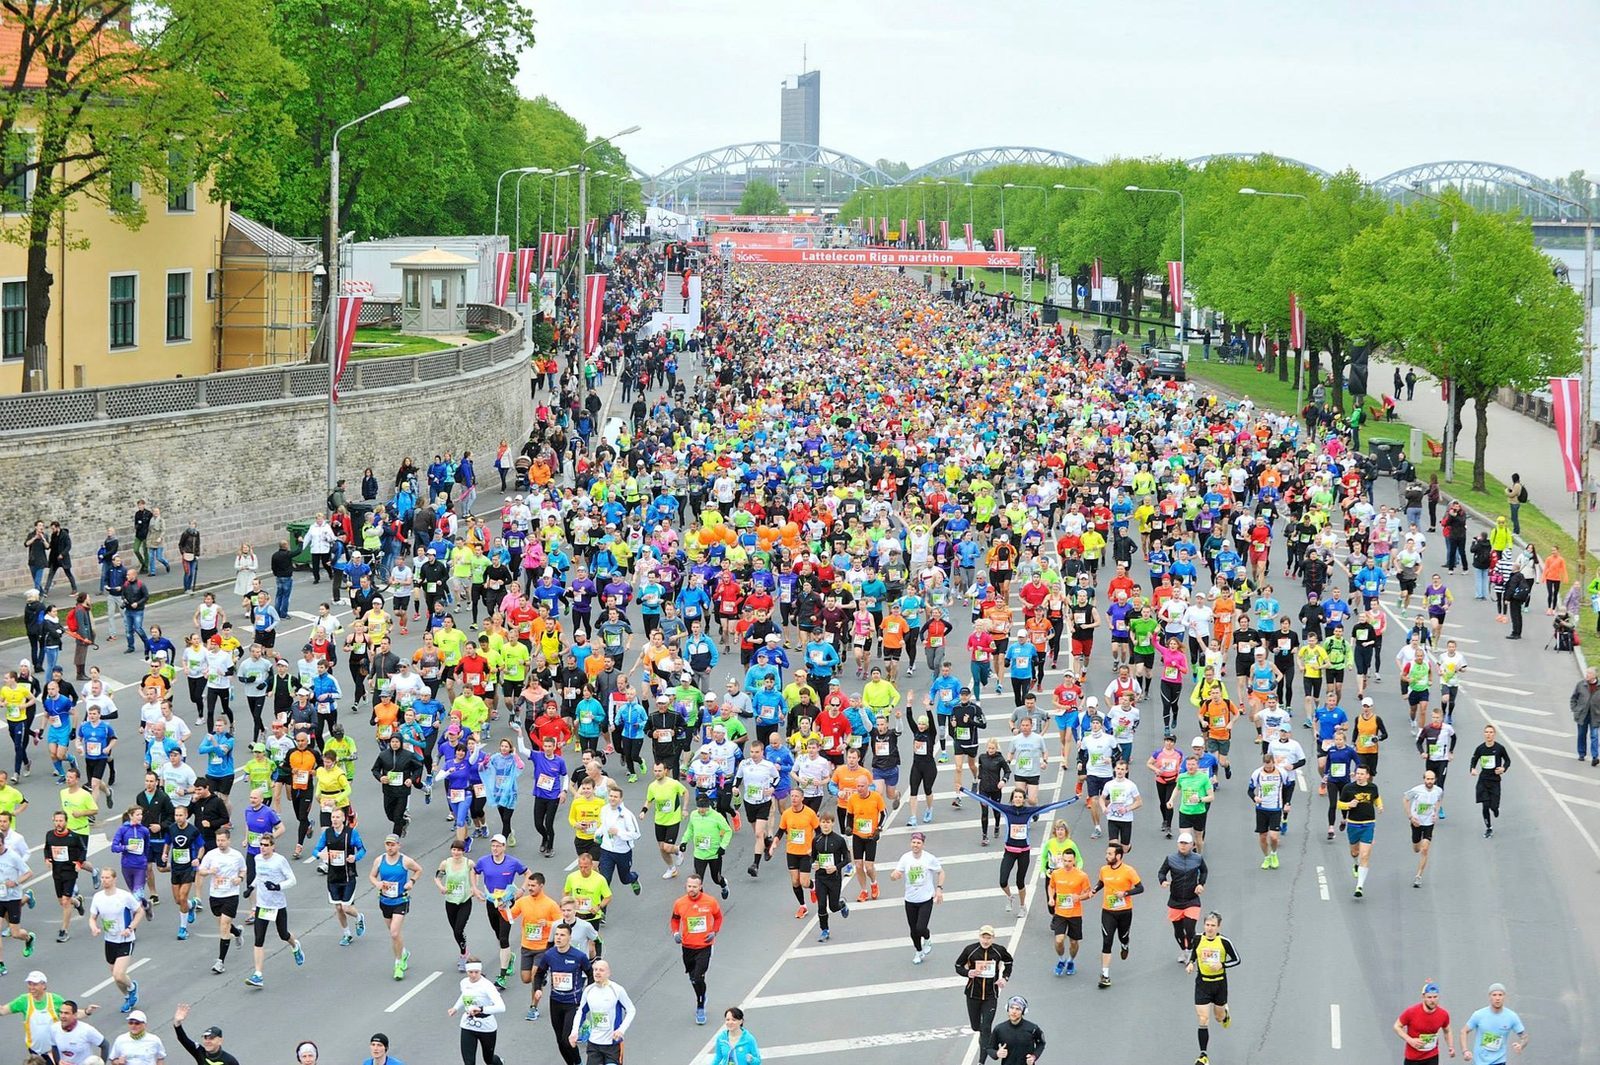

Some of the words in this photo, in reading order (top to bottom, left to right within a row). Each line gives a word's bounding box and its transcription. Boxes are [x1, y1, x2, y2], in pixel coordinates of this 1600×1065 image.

[802, 252, 866, 261] Lattelecom
[869, 252, 895, 263] Riga
[898, 252, 954, 262] marathon
